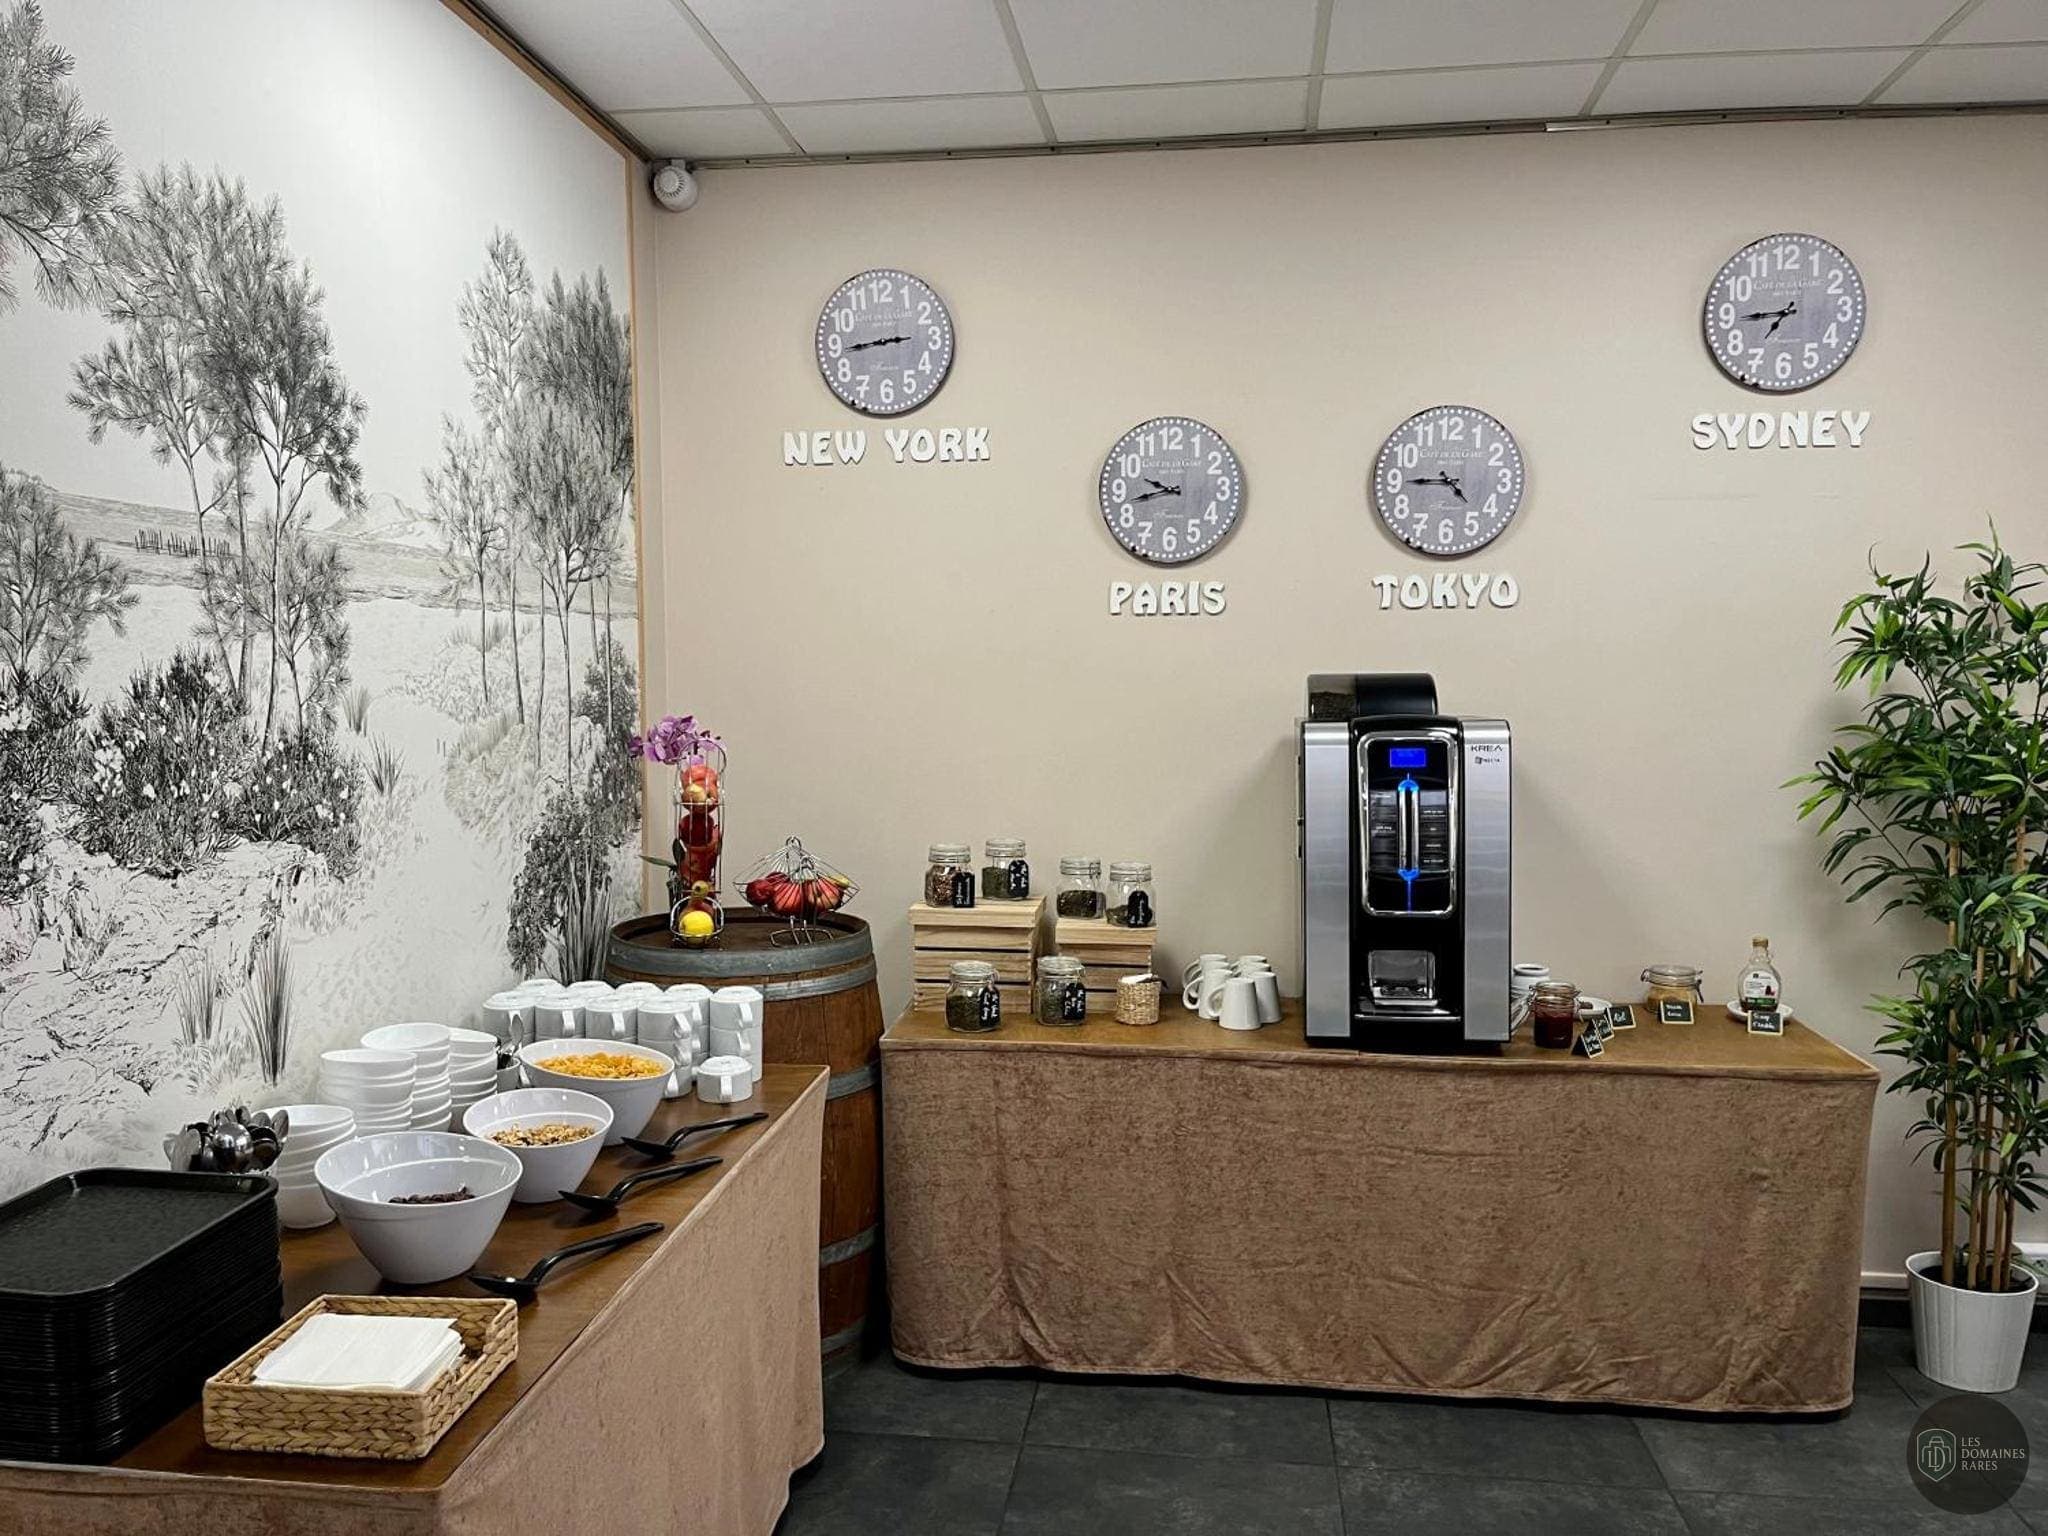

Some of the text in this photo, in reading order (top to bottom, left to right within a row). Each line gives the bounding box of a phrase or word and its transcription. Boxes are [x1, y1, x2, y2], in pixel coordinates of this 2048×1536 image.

[1747, 253, 1767, 277] 11
[1773, 245, 1800, 269] 12
[1809, 252, 1820, 276] 1
[870, 279, 892, 303] 12
[1726, 276, 1751, 301] 10
[1827, 269, 1843, 294] 2
[848, 287, 867, 310] 11
[900, 286, 910, 309] 1
[1837, 296, 1852, 322] 3
[832, 308, 853, 332] 10
[918, 302, 932, 324] 2
[1719, 303, 1734, 329] 9
[828, 334, 841, 358] 9
[928, 327, 941, 350] 3
[1728, 330, 1744, 355] 8
[1823, 323, 1839, 348] 4
[919, 351, 932, 374] 4
[1748, 348, 1764, 373] 7
[1775, 352, 1791, 378] 6
[1803, 343, 1819, 369] 5
[838, 358, 851, 382] 8
[903, 370, 916, 393] 5
[856, 375, 870, 399] 7
[880, 379, 894, 403] 6
[1159, 427, 1183, 450] 12
[1414, 423, 1433, 446] 11
[1438, 417, 1464, 440] 12
[1472, 425, 1482, 448] 1
[1691, 409, 1871, 449] SYDNEY
[784, 428, 991, 465] NEW YORK
[1136, 433, 1154, 456] 11
[1191, 434, 1200, 457] 1
[1394, 443, 1417, 468] 10
[1488, 443, 1504, 466] 2
[1117, 454, 1140, 477] 10
[1207, 452, 1222, 475] 2
[1112, 479, 1126, 503] 9
[1216, 477, 1230, 501] 3
[1387, 469, 1402, 493] 9
[1497, 468, 1511, 493] 3
[1120, 504, 1134, 527] 8
[1204, 501, 1218, 525] 4
[1394, 495, 1409, 519] 8
[1483, 494, 1498, 517] 4
[1138, 521, 1152, 544] 7
[1187, 519, 1200, 543] 5
[1412, 513, 1428, 537] 7
[1438, 519, 1453, 543] 6
[1464, 512, 1479, 536] 5
[1162, 527, 1177, 551] 6
[1109, 581, 1226, 616] PARIS
[1372, 573, 1520, 609] TOKYO
